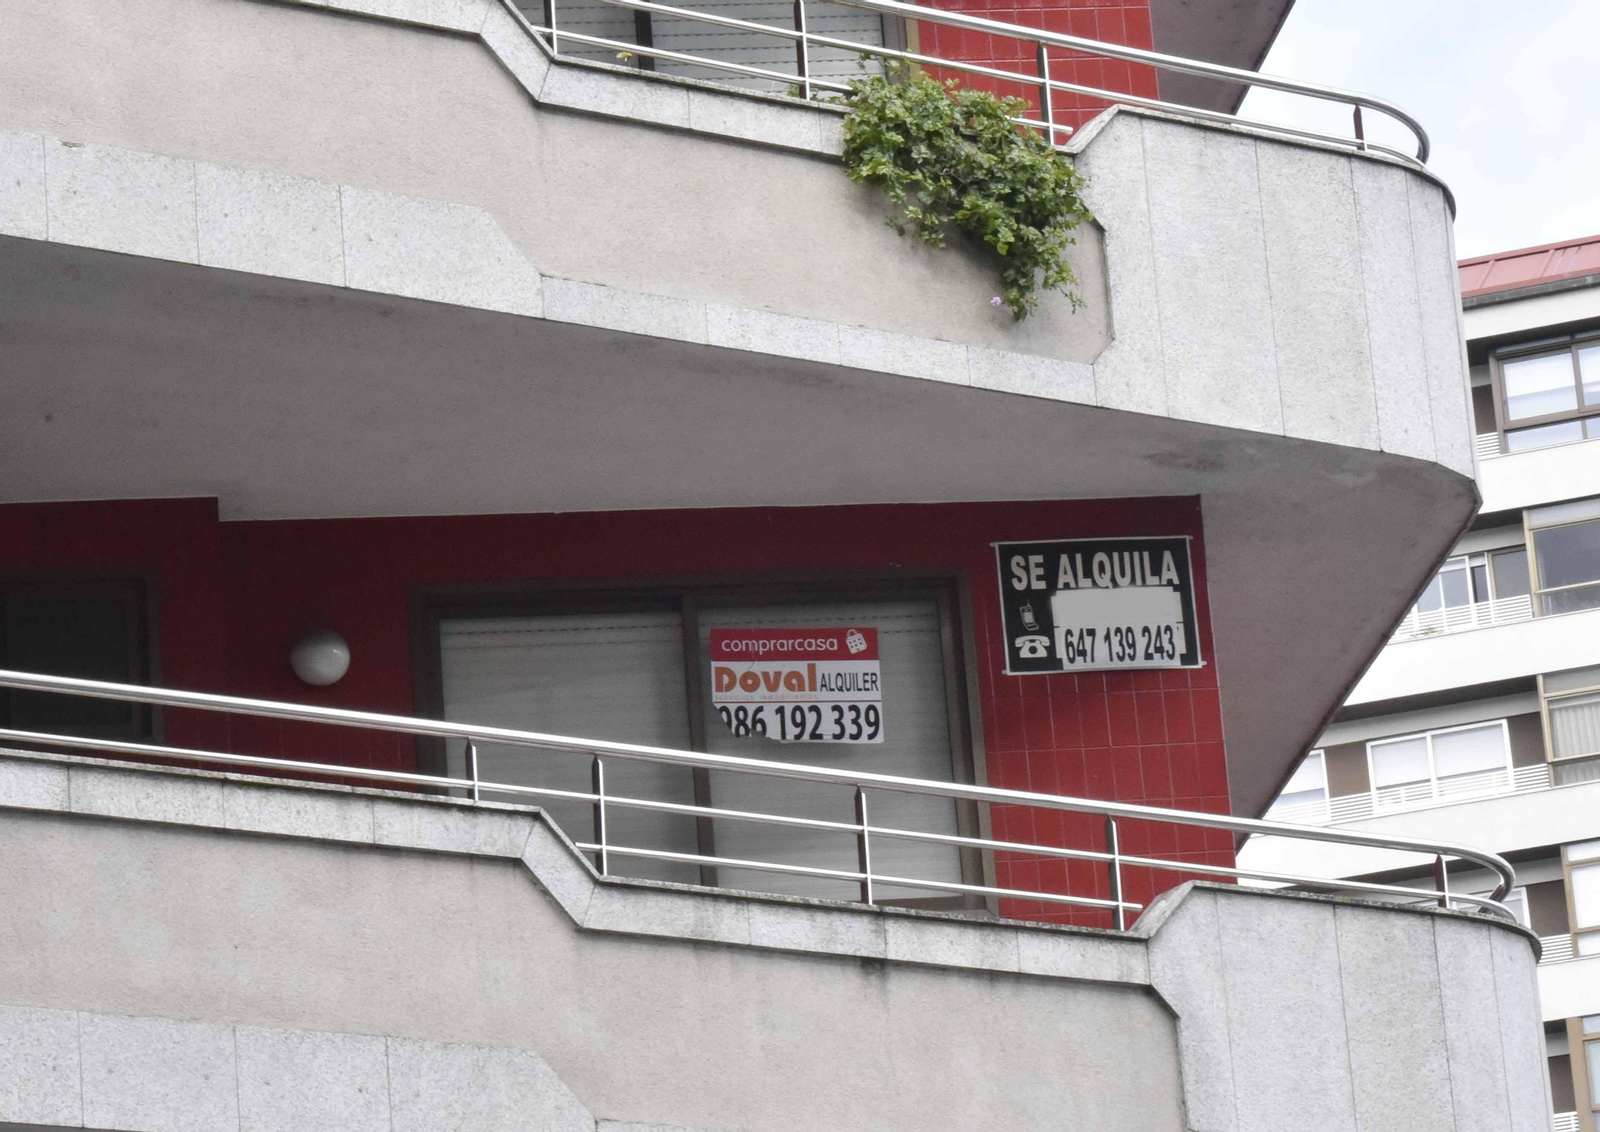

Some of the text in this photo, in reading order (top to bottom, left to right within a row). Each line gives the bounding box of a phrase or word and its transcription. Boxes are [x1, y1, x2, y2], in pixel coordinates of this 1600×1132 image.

[1010, 550, 1180, 591] SE ALQUILA
[721, 637, 838, 655] comprarcasa
[1064, 624, 1176, 664] 647 139 243
[714, 663, 818, 693] Doval
[819, 672, 879, 693] ALQUILER
[774, 704, 824, 741] 192
[830, 704, 880, 741] 339
